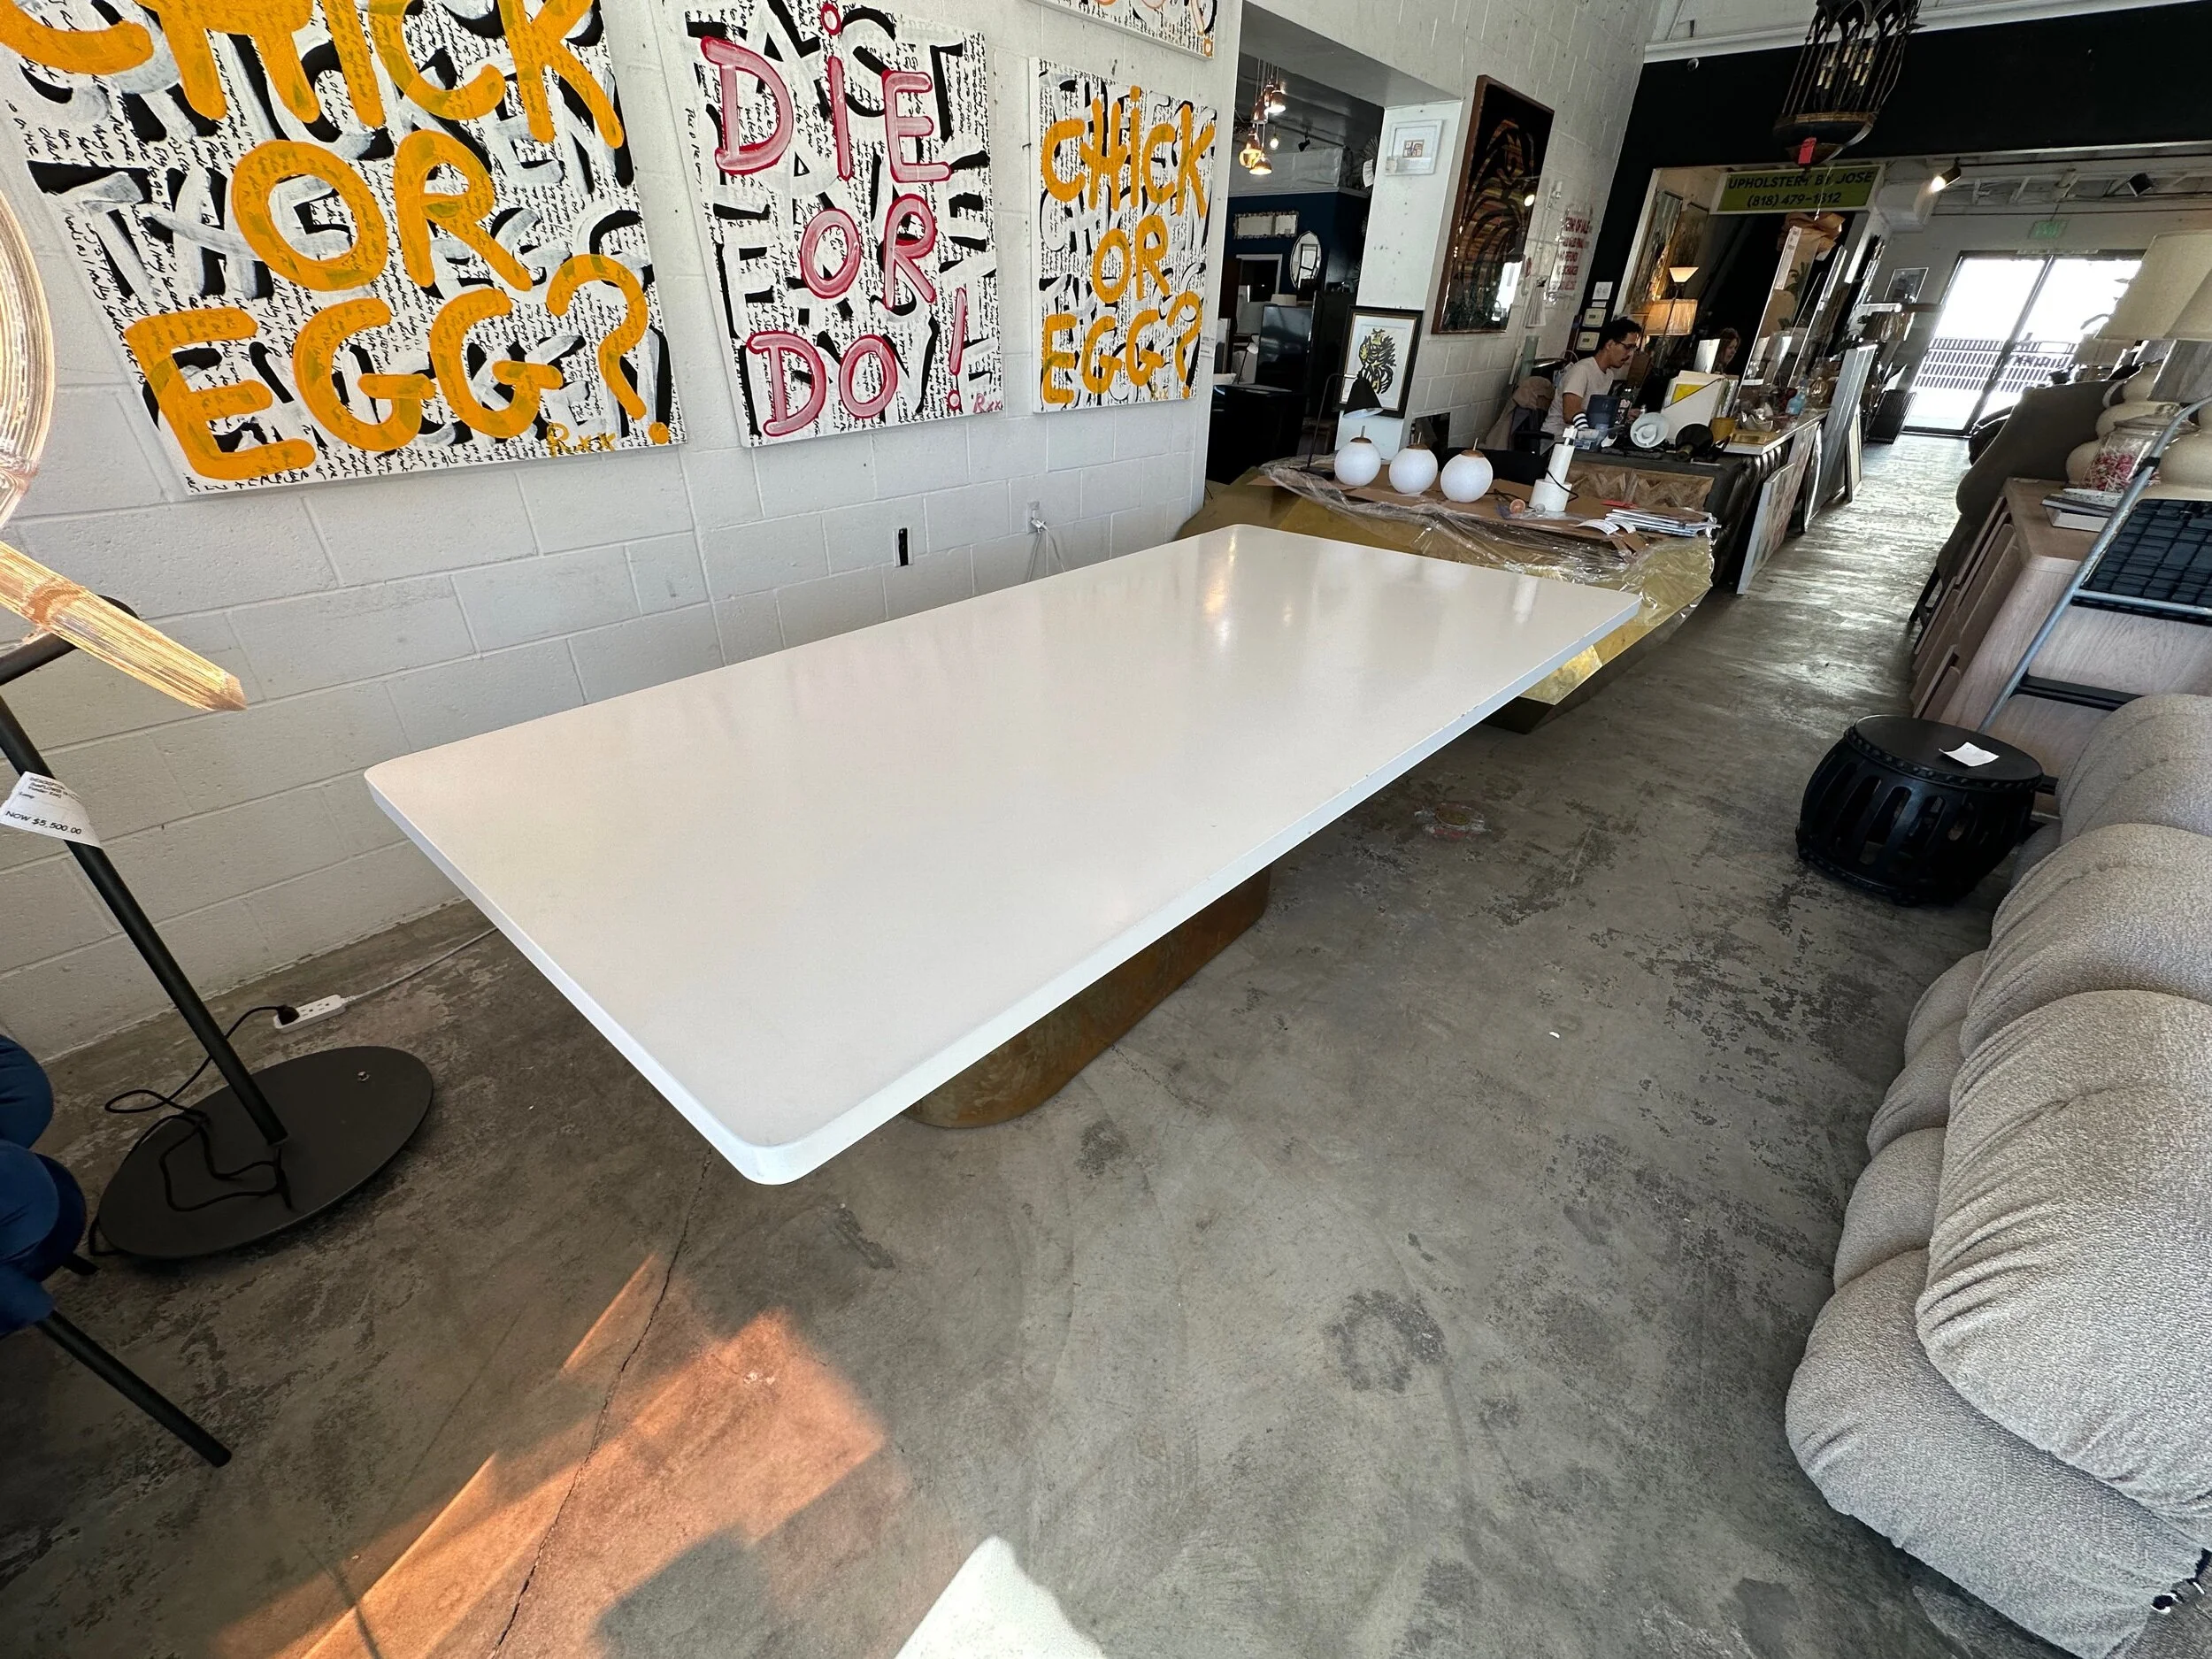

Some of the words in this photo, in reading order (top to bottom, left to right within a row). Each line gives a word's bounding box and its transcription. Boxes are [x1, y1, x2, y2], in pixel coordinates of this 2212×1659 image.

[232, 129, 533, 291] OR
[1747, 194, 1778, 208] (818)
[1815, 173, 1834, 186] BY
[1836, 171, 1875, 185] JOSE
[801, 194, 936, 310] OR
[1092, 214, 1171, 303] OR
[126, 254, 670, 480] EGG?
[746, 288, 968, 436] DO!
[1042, 290, 1204, 404] EGG?
[5, 810, 32, 822] NOW
[32, 818, 82, 835] $5,500.00
